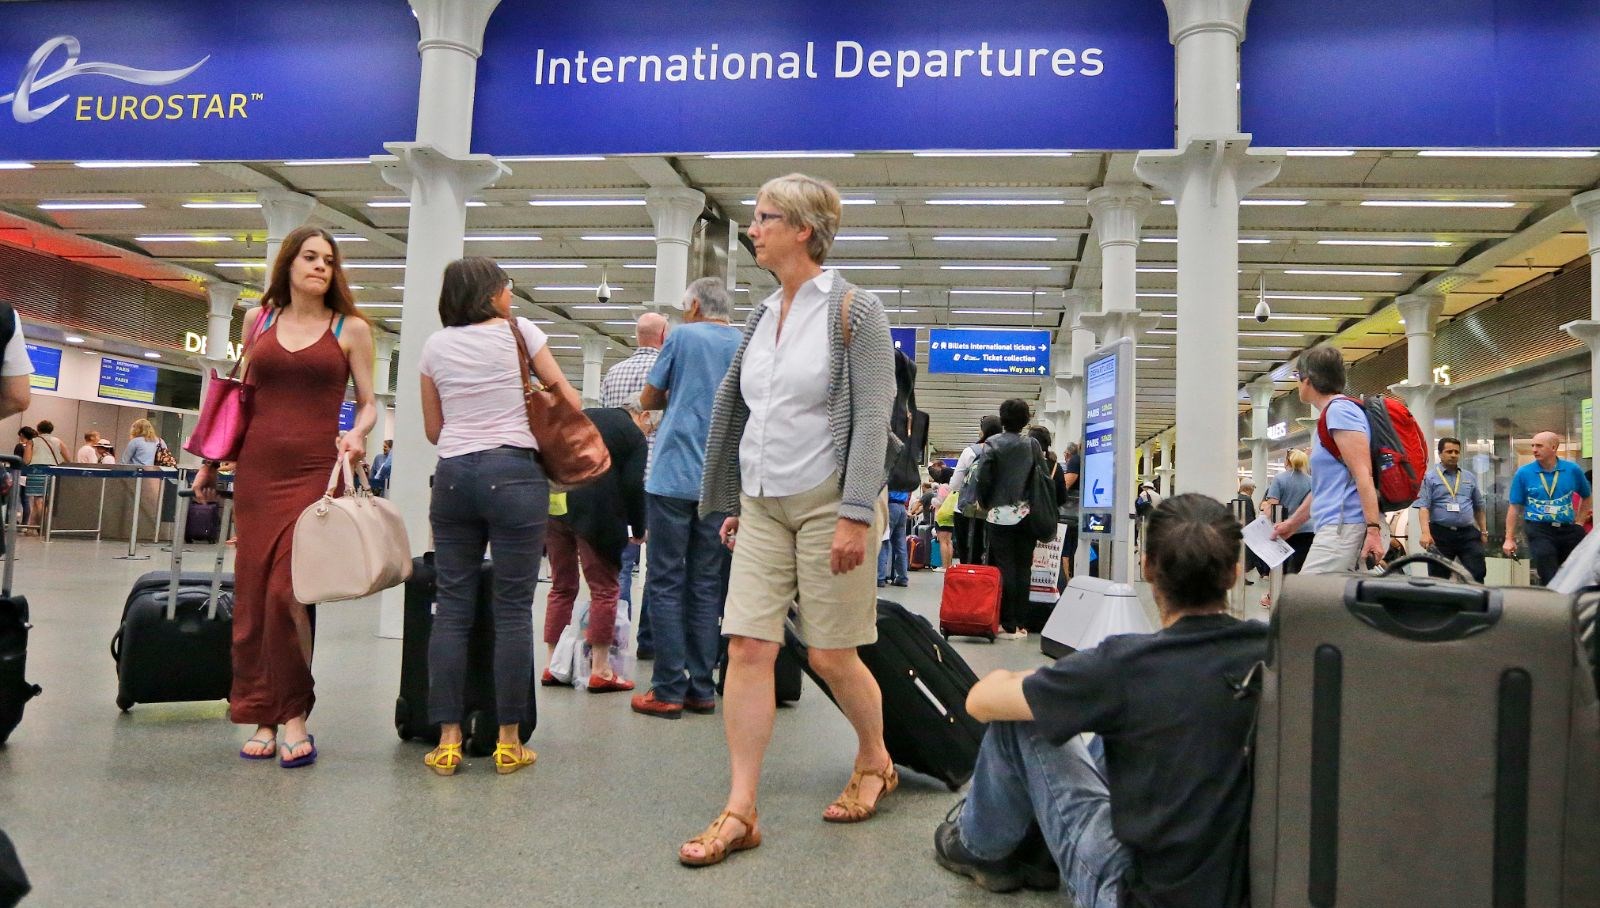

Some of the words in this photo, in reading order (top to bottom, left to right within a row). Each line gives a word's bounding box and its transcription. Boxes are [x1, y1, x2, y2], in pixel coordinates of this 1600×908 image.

[535, 41, 818, 85] International
[834, 40, 1105, 88] Departures
[948, 342, 969, 350] Billets
[1013, 343, 1036, 351] tickets
[982, 354, 1003, 362] Ticket
[1003, 355, 1036, 363] collection
[1009, 365, 1024, 373] Way
[1086, 407, 1099, 419] PARIS
[1086, 438, 1099, 448] PARIS
